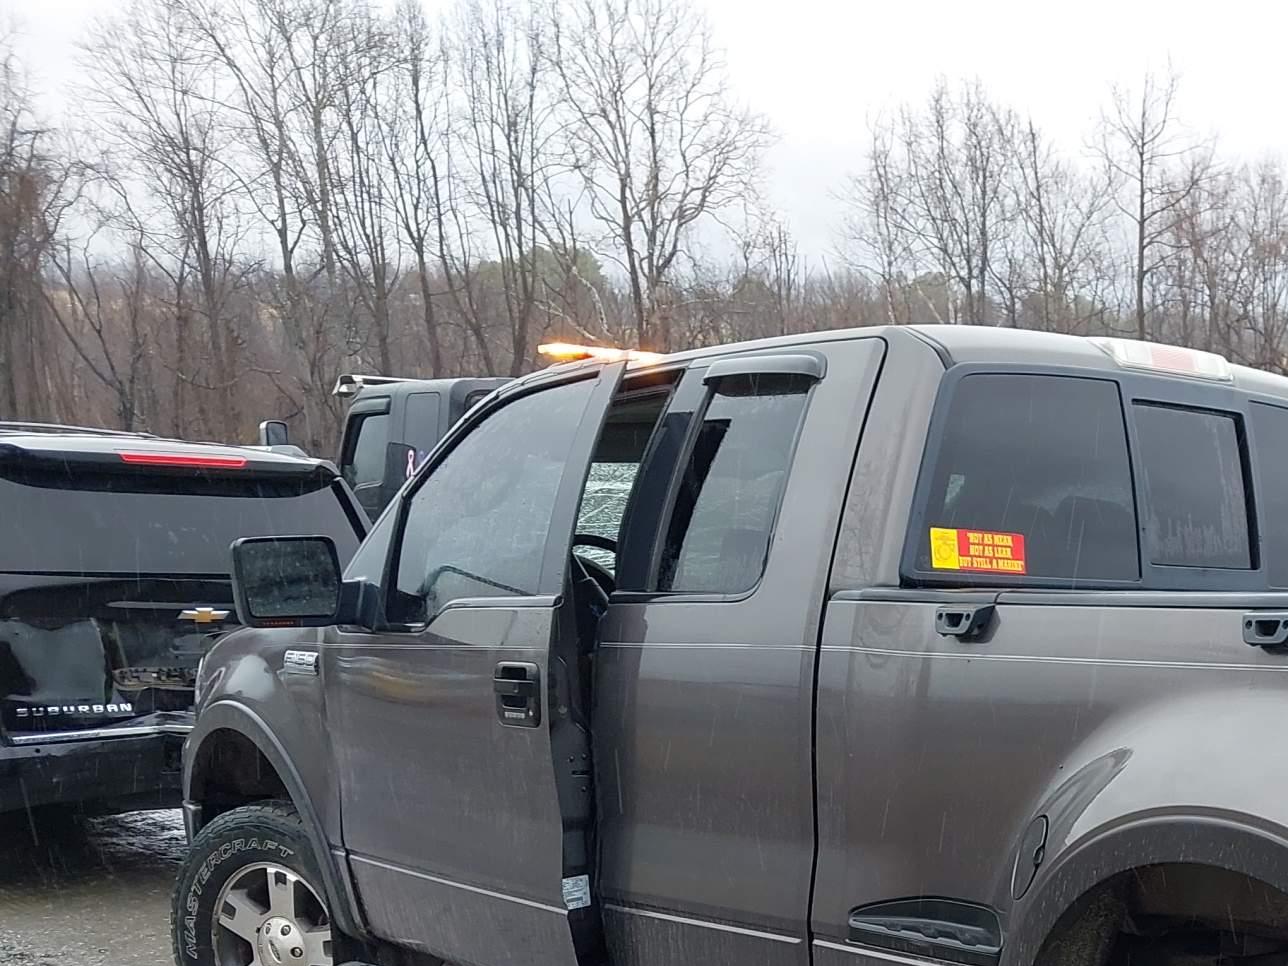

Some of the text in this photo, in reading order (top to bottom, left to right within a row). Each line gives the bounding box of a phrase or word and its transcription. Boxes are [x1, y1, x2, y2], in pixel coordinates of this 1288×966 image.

[984, 533, 993, 545] AS
[969, 544, 984, 556] NOT
[984, 546, 993, 557] AS
[959, 556, 972, 567] BUT
[972, 557, 992, 569] STILL
[15, 702, 133, 718] SUBURBAN
[185, 837, 295, 960] MASTERCRAFT
